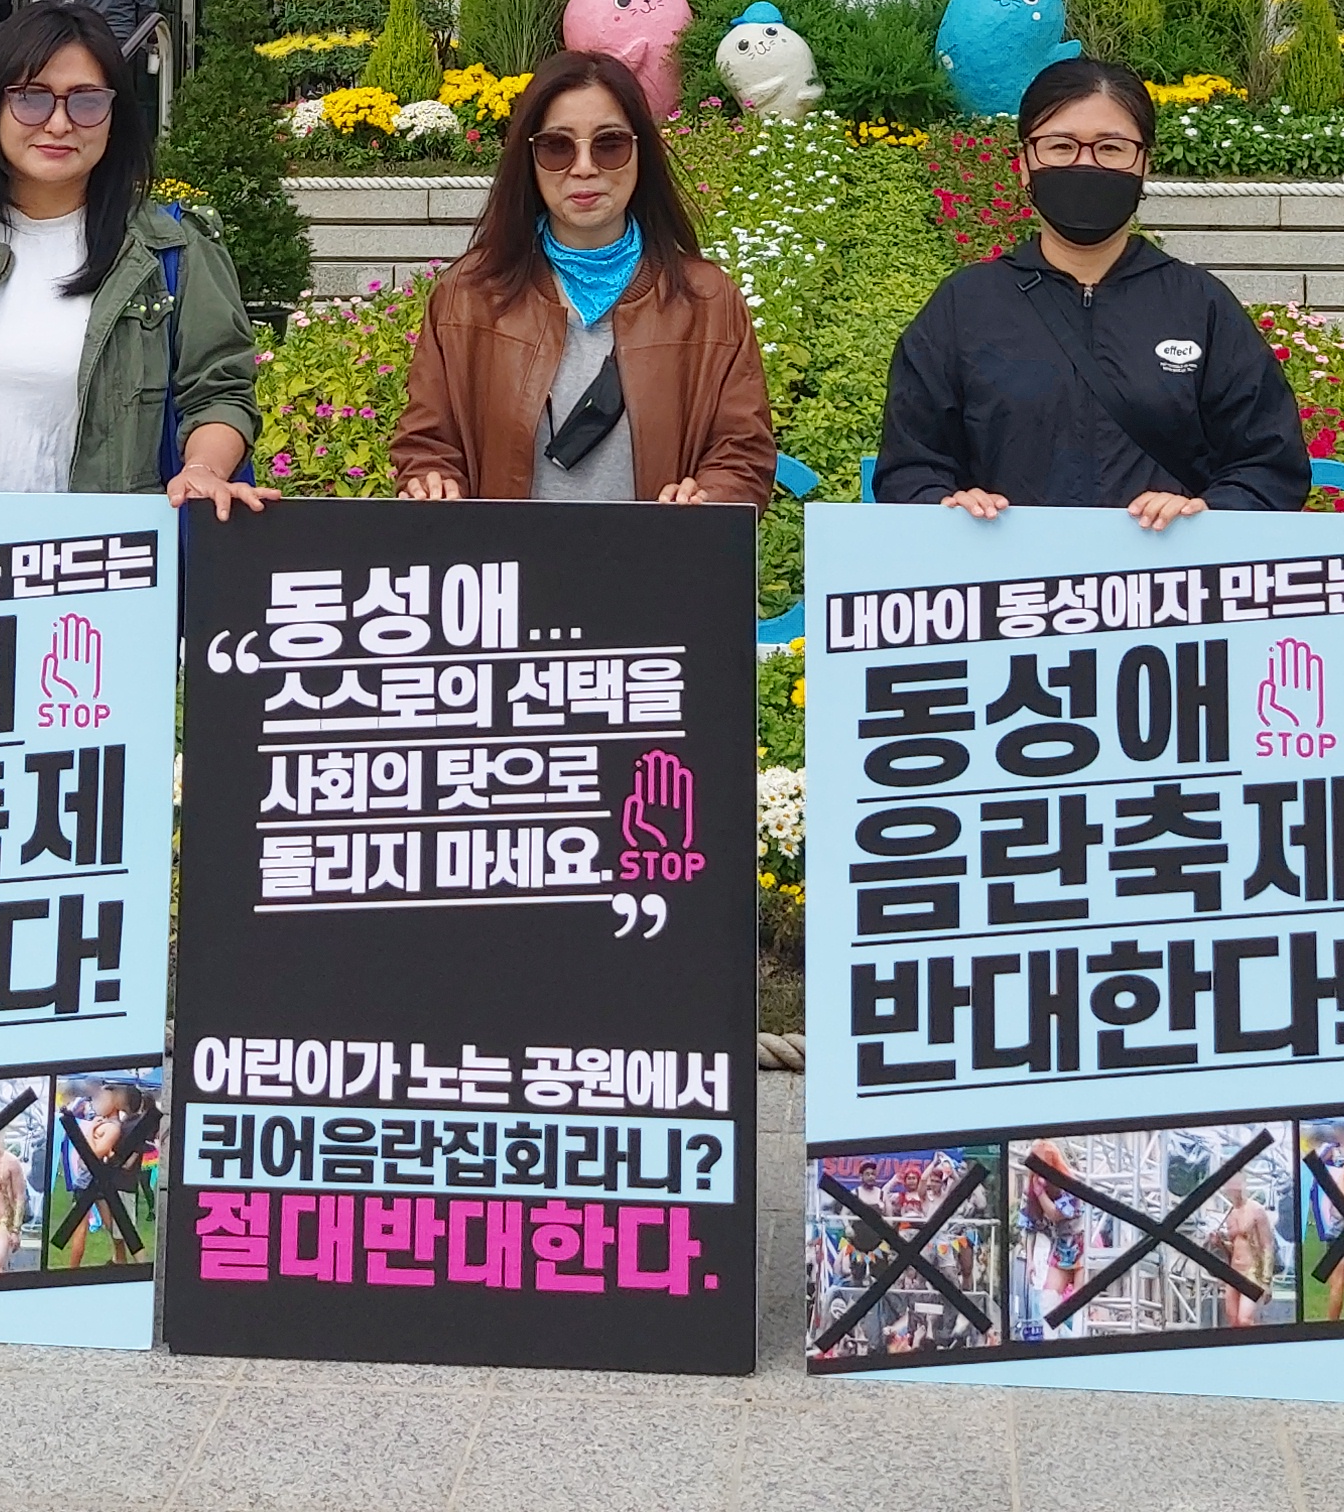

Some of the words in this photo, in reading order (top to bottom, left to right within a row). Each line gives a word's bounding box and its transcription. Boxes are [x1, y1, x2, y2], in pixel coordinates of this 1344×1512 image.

[13, 538, 154, 591] 만드는
[830, 586, 980, 651] 내아이
[995, 567, 1208, 638] 동성애자
[38, 703, 111, 729] STOP
[262, 663, 493, 733] 스스로의
[507, 658, 685, 727] 선택을
[857, 638, 1230, 788] 동성애
[260, 750, 422, 814] 사회의
[436, 745, 601, 808] 탓으로
[1256, 731, 1338, 759] STOP
[259, 831, 421, 898] 돌리지
[619, 850, 706, 882] STOP
[193, 1036, 401, 1101] 어린이가
[407, 1043, 512, 1105] 노는
[522, 1045, 730, 1112] 공원에서
[198, 1114, 723, 1193] 퀴어음란집회라니?
[196, 1191, 719, 1296] 절대반대한다.
